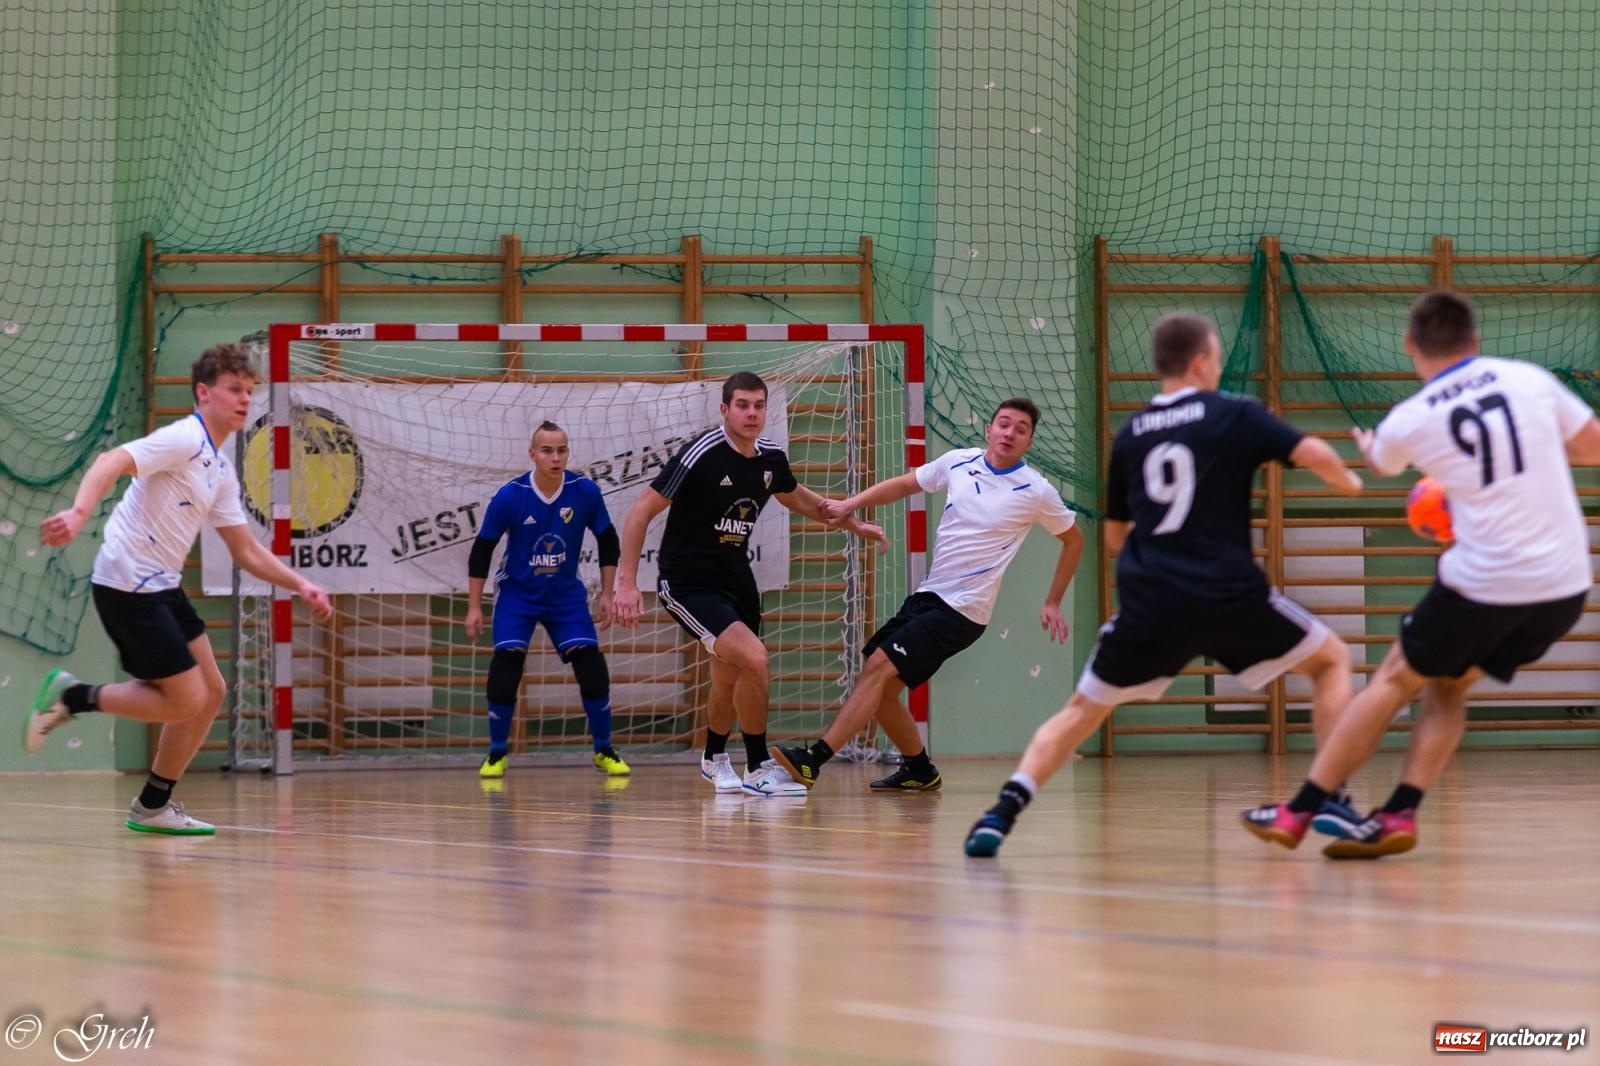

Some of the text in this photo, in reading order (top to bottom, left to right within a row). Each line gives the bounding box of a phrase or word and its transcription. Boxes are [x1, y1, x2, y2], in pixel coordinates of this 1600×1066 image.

[1449, 391, 1524, 488] 97
[1143, 441, 1197, 535] 9
[291, 539, 369, 568] IBÓRZ
[391, 502, 482, 558] JEST
[714, 517, 754, 535] JANET
